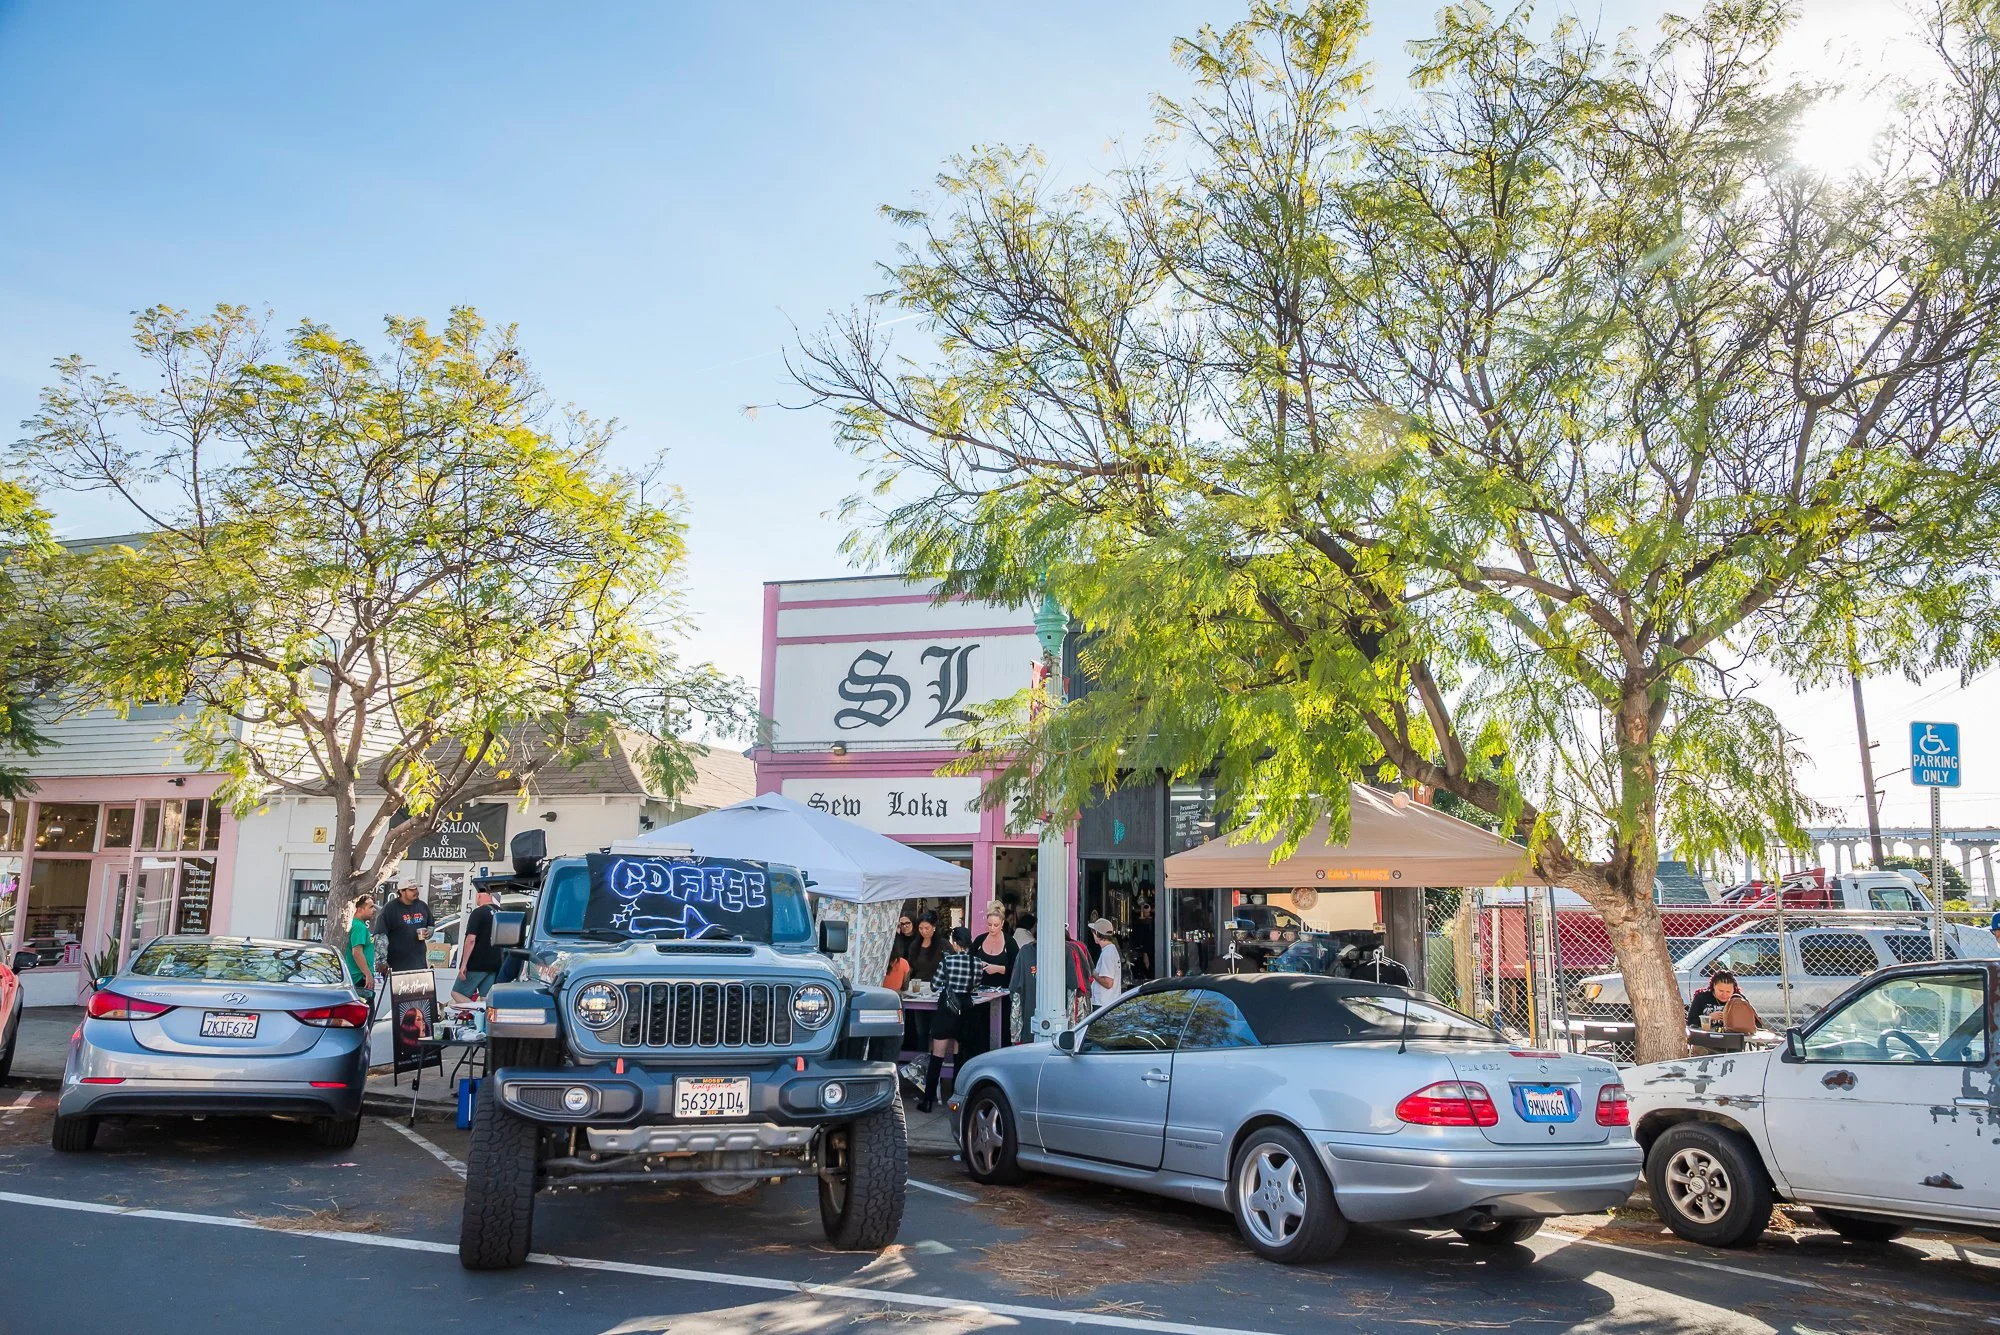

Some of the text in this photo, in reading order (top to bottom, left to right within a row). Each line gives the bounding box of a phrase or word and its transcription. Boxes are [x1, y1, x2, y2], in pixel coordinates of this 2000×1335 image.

[1913, 754, 1958, 768] PARKING
[1922, 770, 1949, 782] ONLY
[807, 791, 949, 818] Sew Loka
[442, 821, 481, 834] SALON
[440, 834, 450, 846] &
[422, 846, 467, 859] BARBER
[611, 858, 766, 912] COFFEE
[681, 1092, 744, 1111] 56391D4
[1528, 1099, 1569, 1116] 9MWV661
